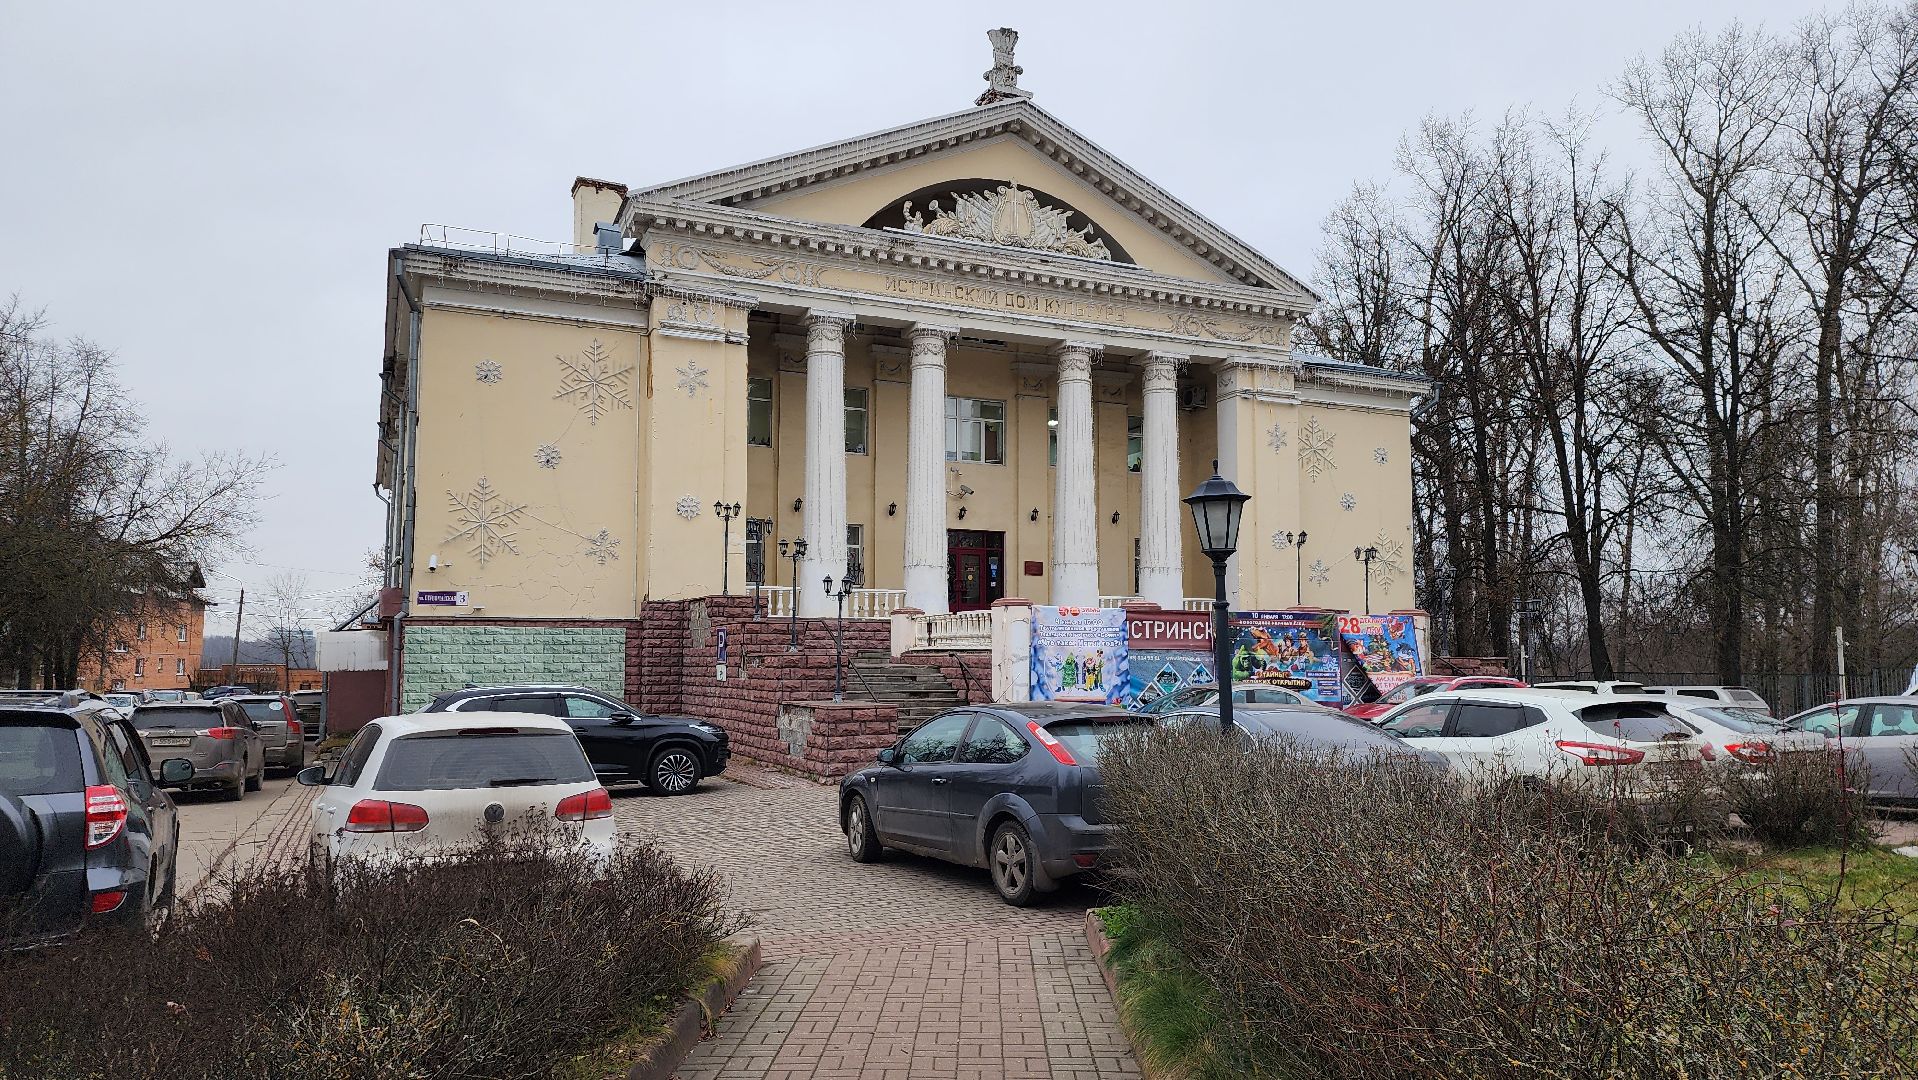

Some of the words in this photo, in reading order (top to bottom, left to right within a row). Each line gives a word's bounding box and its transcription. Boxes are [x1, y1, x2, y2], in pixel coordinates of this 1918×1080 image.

[885, 276, 998, 305] ИСТРИНСКИЙ
[1006, 293, 1039, 310] ДОМ
[1338, 617, 1361, 634] 28
